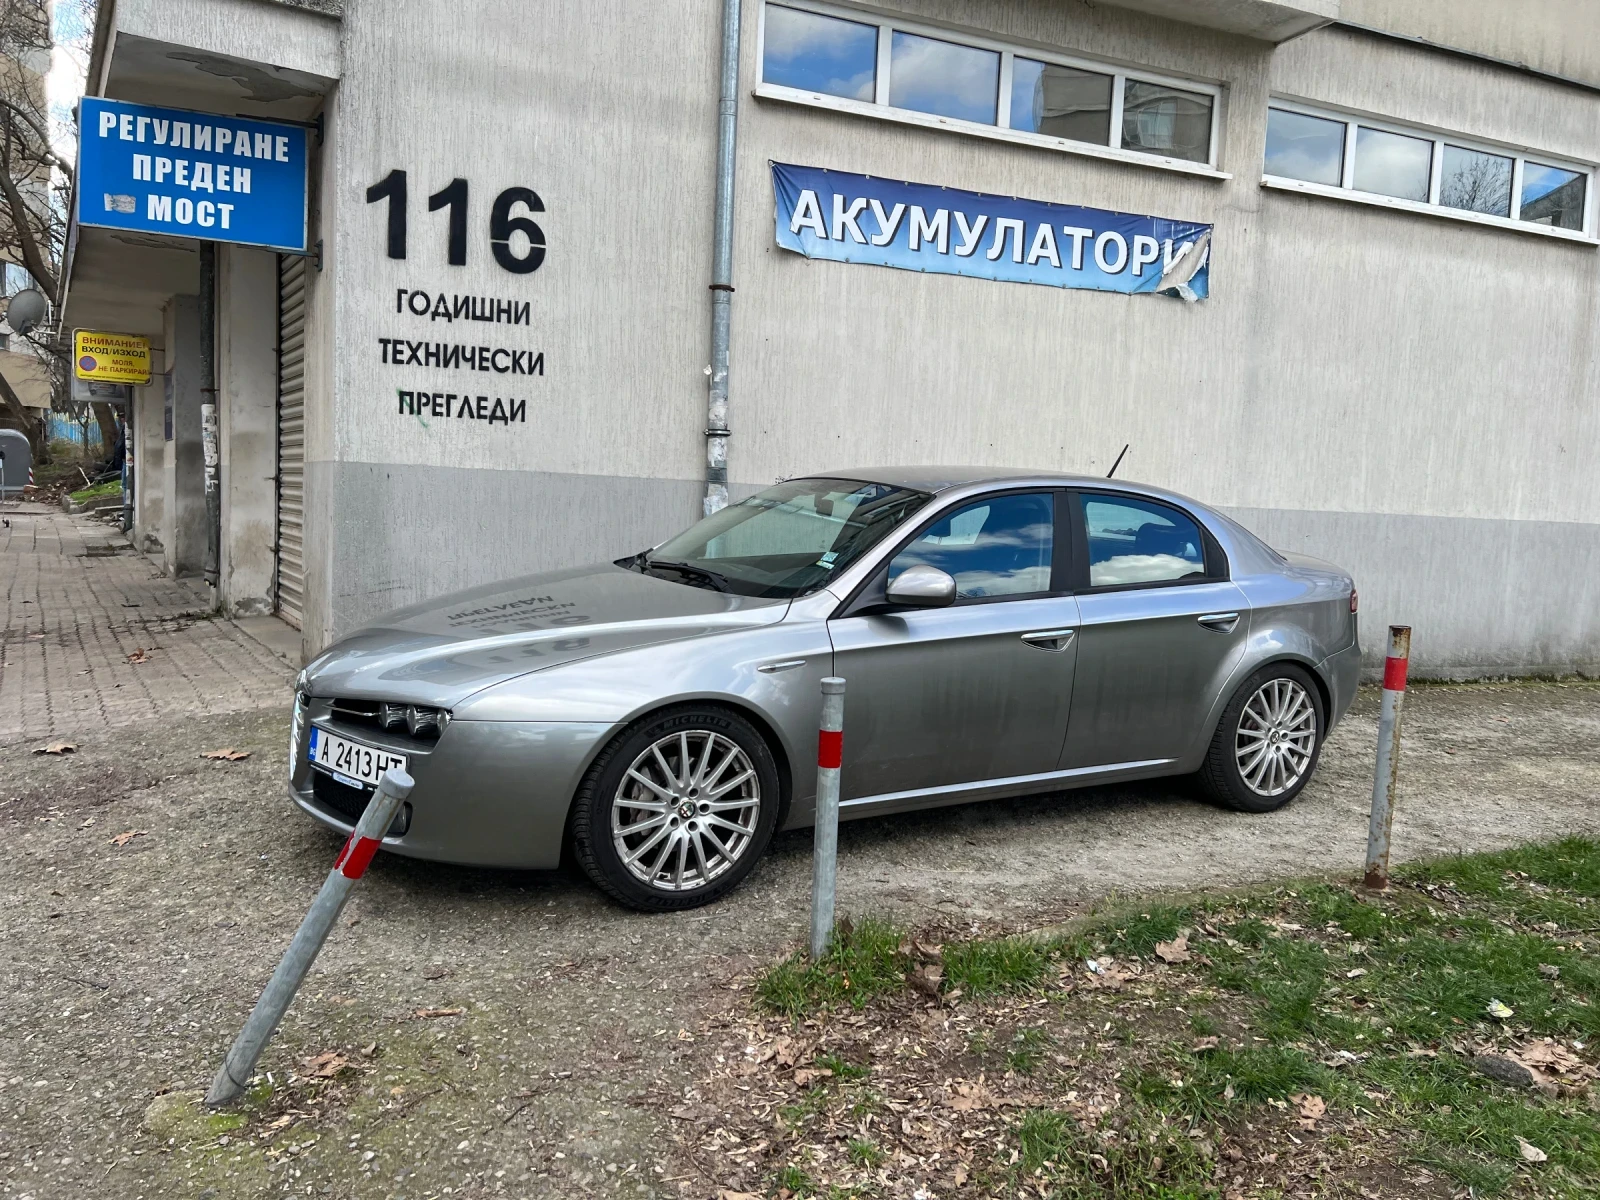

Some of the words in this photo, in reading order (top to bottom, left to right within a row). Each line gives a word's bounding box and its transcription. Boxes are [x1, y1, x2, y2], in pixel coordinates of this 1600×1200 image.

[99, 111, 289, 162] РЕГУЛИРАНЕ
[133, 154, 251, 194] ПРЕДЕН
[147, 194, 235, 229] МОСТ
[366, 169, 547, 275] 116
[396, 288, 531, 326] ГОДИШНИ
[81, 346, 146, 358] ВХОД/ИЗХОД
[82, 336, 146, 349] ВНИМАНИЕ!
[378, 338, 545, 376] ТЕХНИЧЕСКИ
[112, 359, 135, 367] МОЛЯ,
[398, 391, 526, 426] ПРЕГЛЕДИ
[663, 715, 729, 729] MICHELIN
[336, 742, 372, 777] 2413
